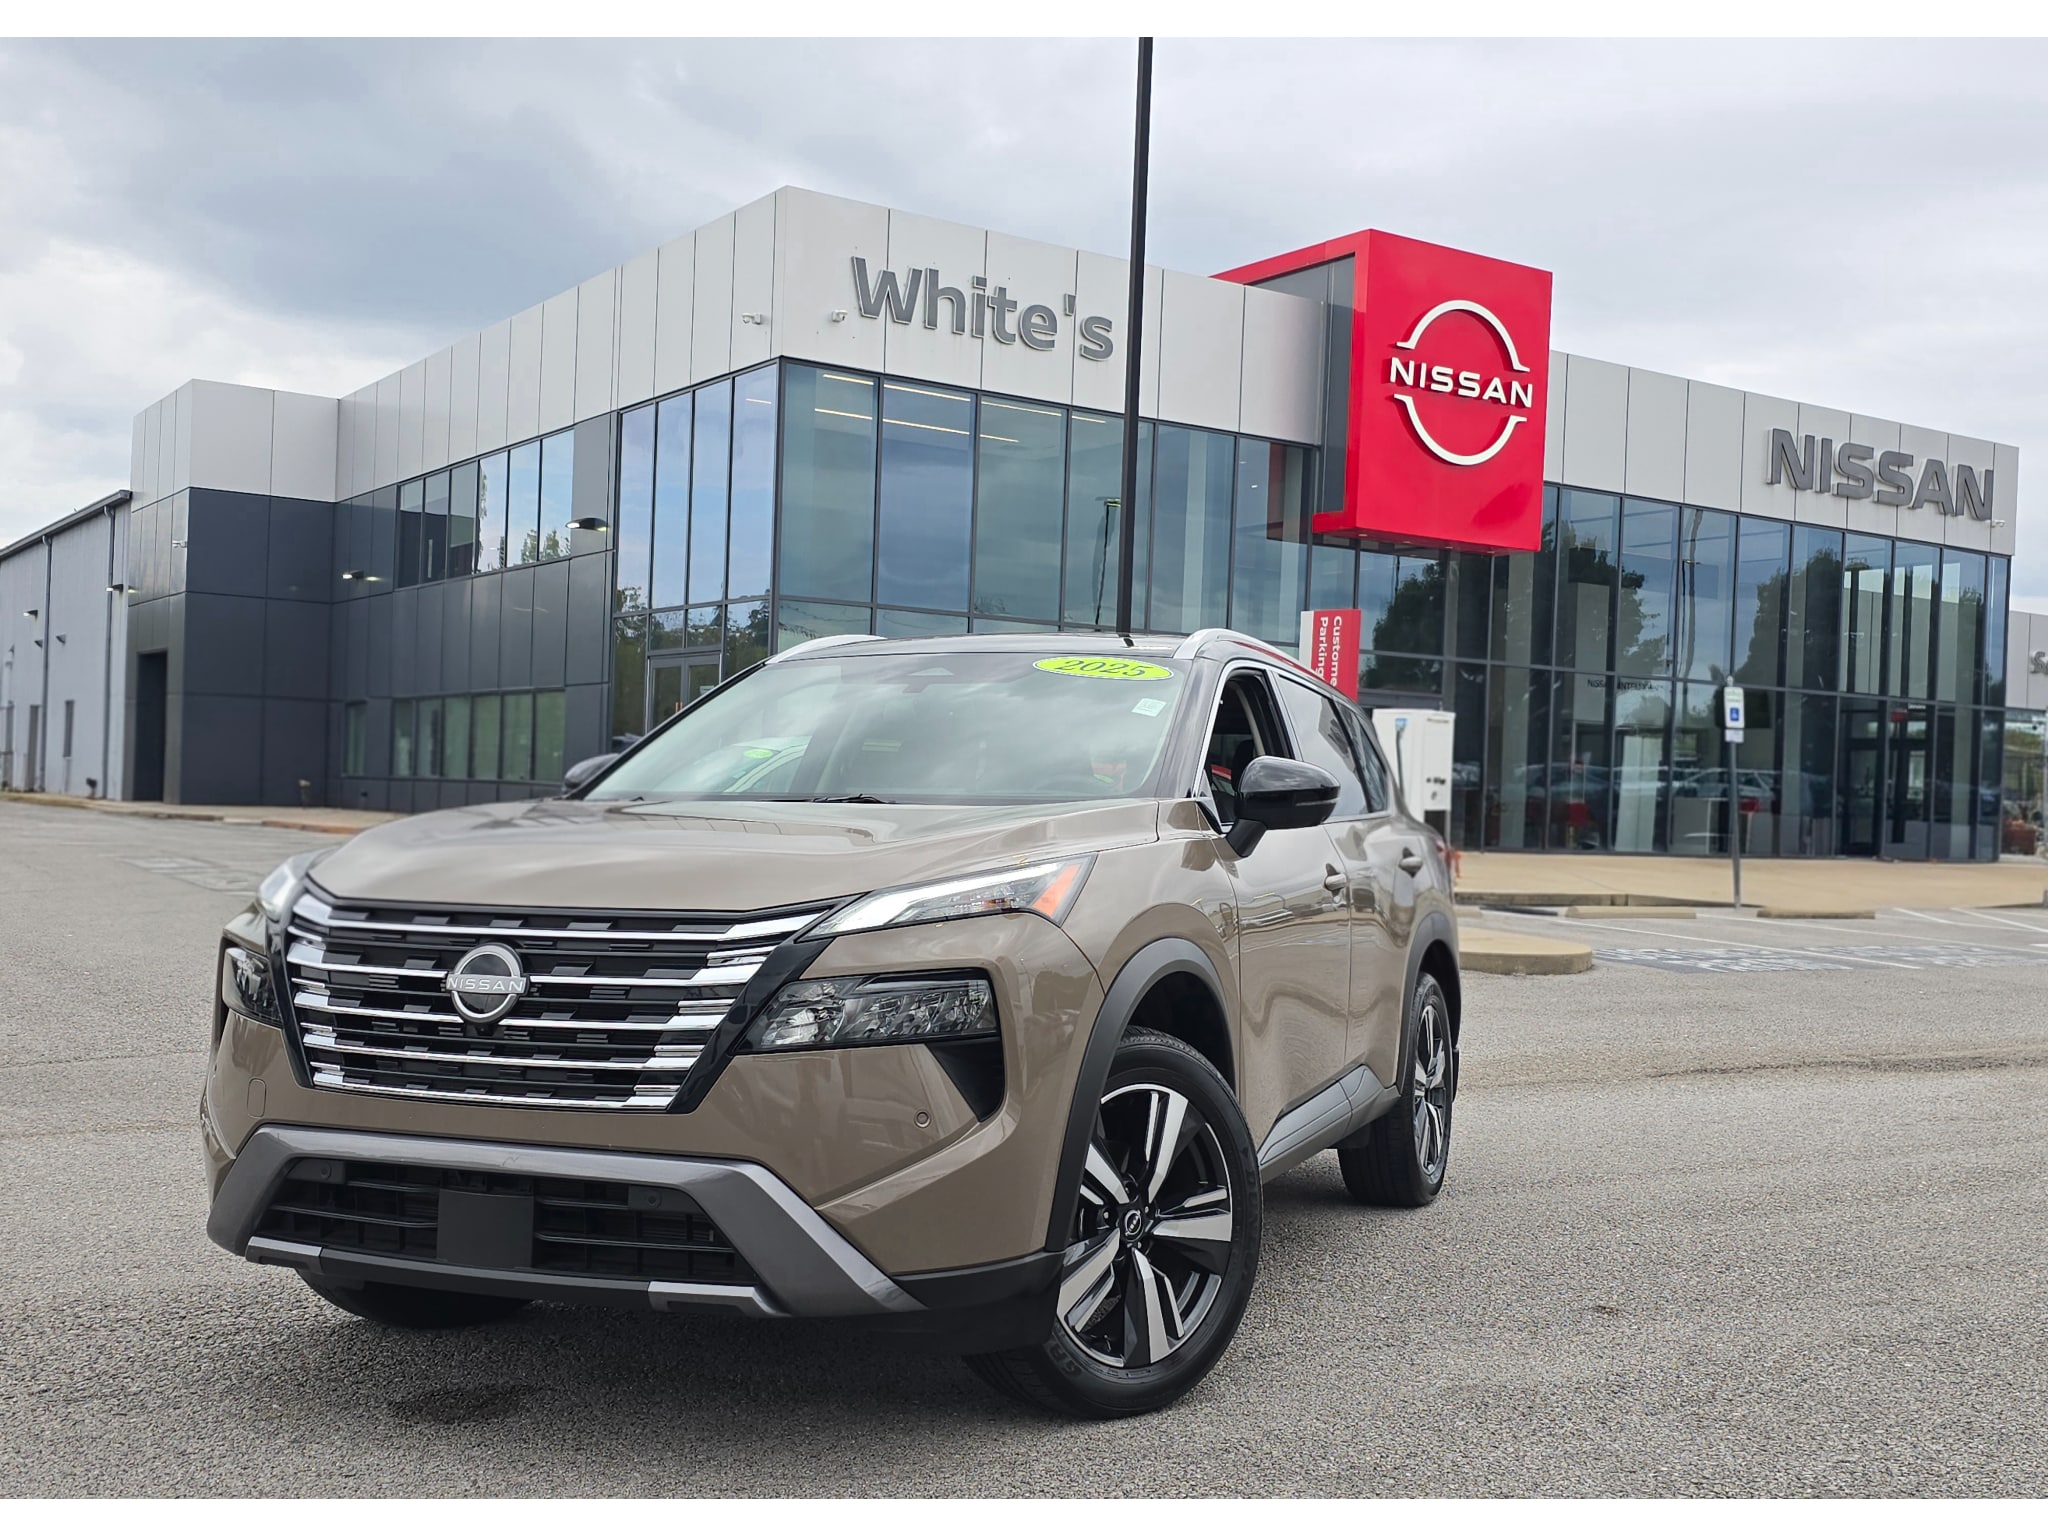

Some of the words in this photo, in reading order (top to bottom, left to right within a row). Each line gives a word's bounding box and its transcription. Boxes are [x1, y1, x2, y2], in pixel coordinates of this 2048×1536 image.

[851, 256, 1114, 361] White's
[1389, 356, 1533, 408] NISSAN
[1767, 428, 1994, 520] NISSAN
[1054, 659, 1153, 677] 2025
[1330, 616, 1342, 686] Custome
[447, 977, 523, 992] NISSAN
